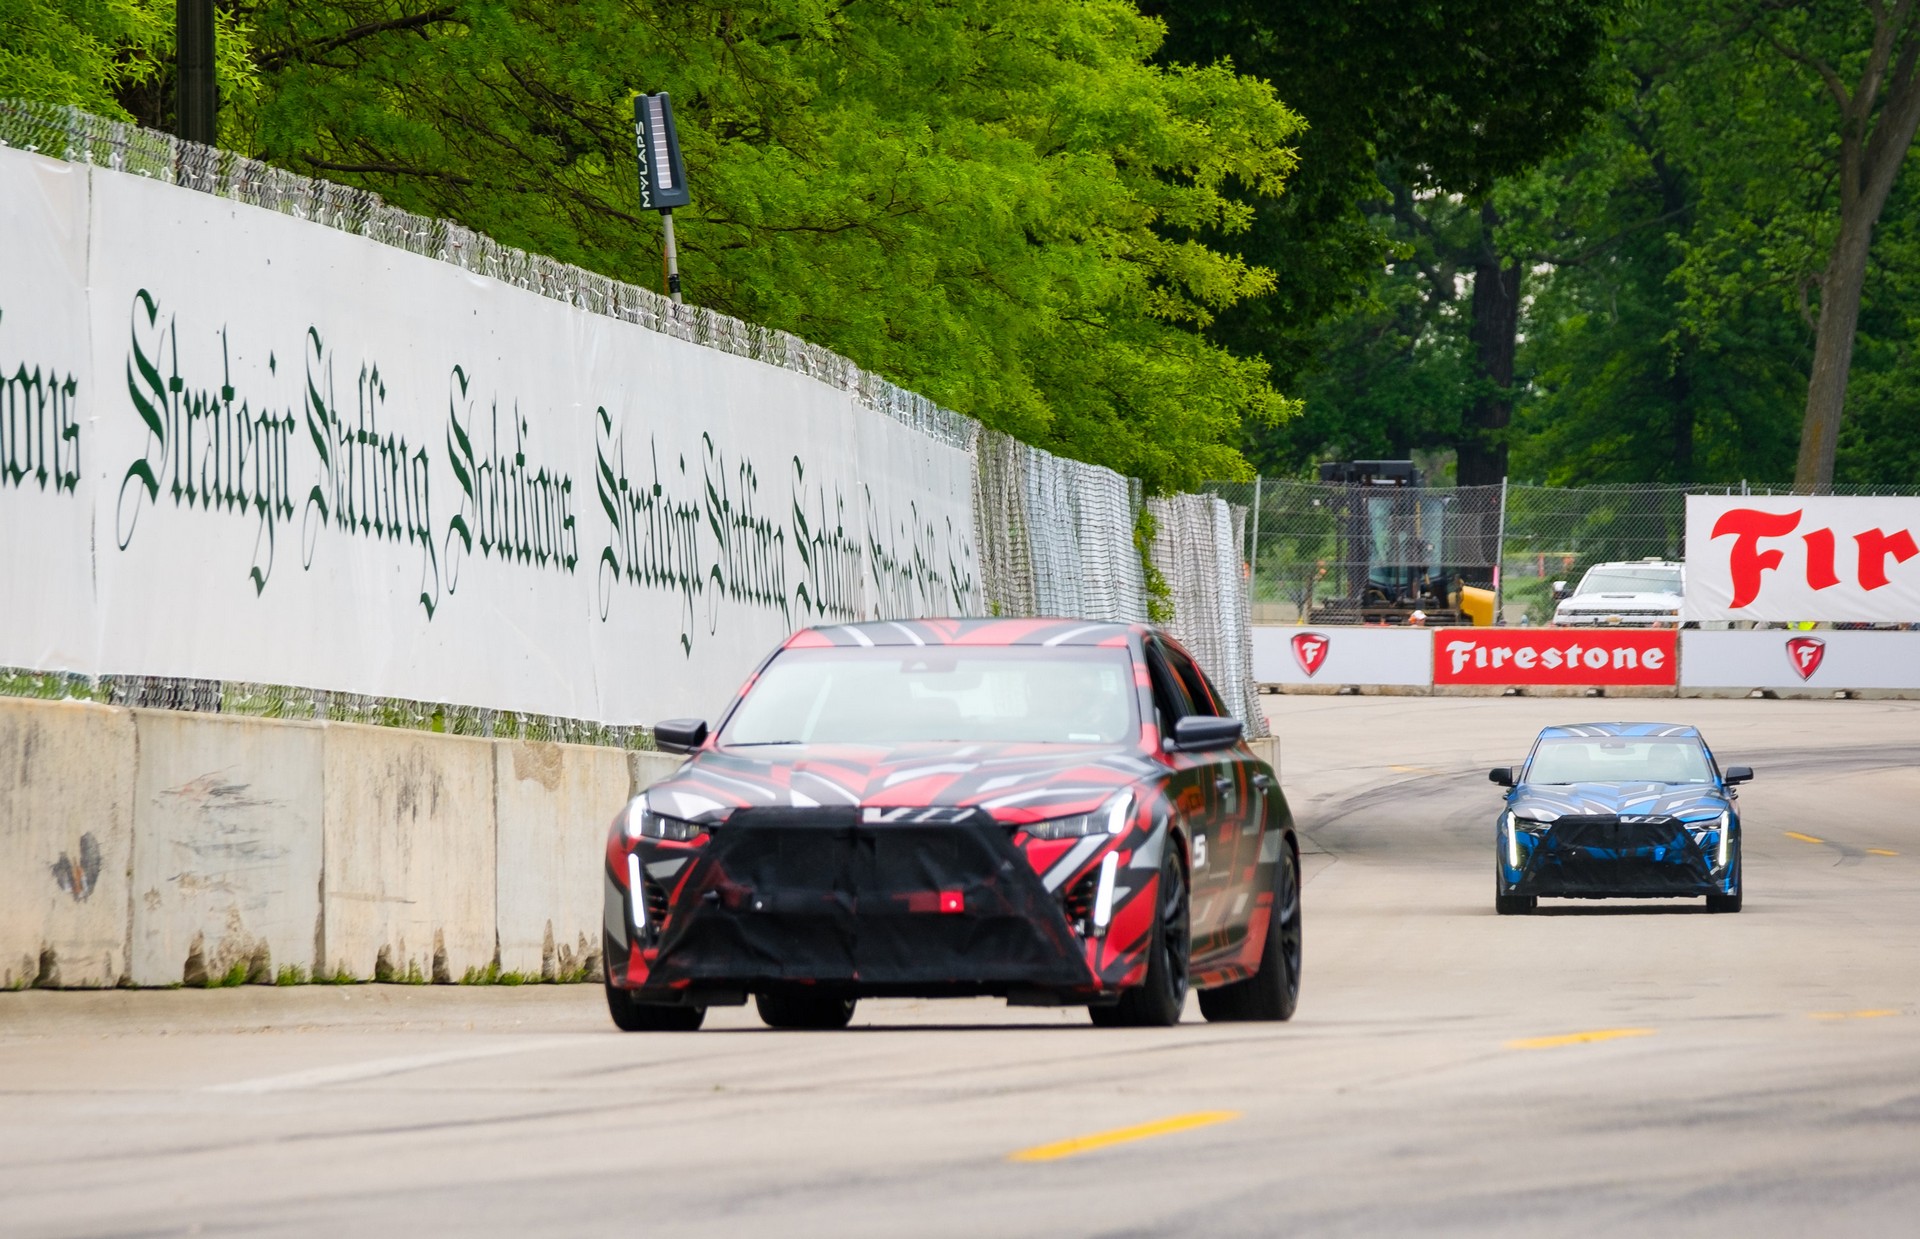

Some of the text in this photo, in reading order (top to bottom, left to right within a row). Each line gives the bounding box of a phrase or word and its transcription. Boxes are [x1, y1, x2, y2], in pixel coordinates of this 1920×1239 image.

[117, 288, 296, 598] Strategic
[303, 326, 439, 622] Staffing
[445, 364, 578, 595] Solutions
[595, 406, 703, 660] Strategic
[1445, 640, 1665, 675] Firestone
